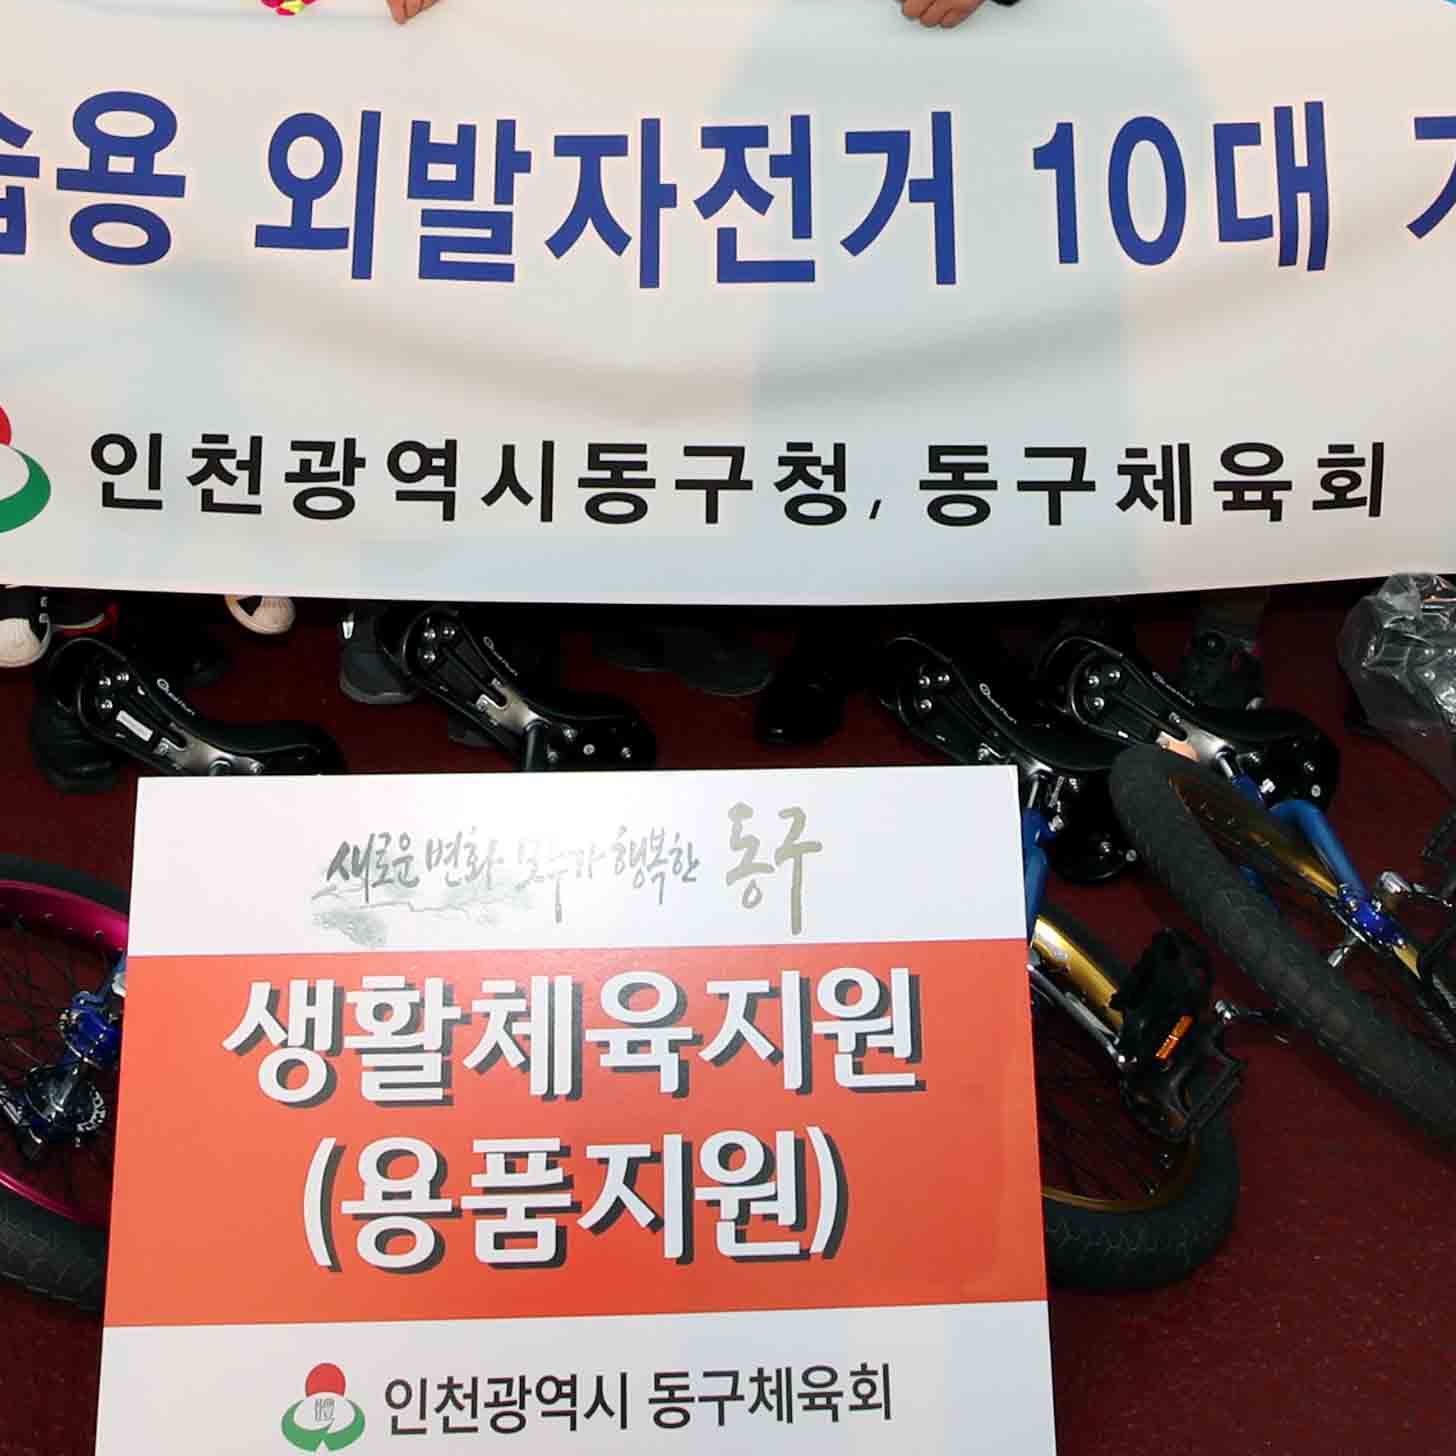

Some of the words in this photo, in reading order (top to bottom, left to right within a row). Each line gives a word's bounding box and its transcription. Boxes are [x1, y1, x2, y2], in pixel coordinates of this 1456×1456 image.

[255, 111, 956, 289] 외발자전거
[1033, 101, 1329, 272] 10대
[90, 432, 882, 526] 인천광역시동구청,
[919, 442, 1385, 527] 동구체육회
[326, 831, 420, 903] 새로운
[613, 824, 702, 905] 행복한
[725, 802, 823, 935] 동구
[222, 966, 925, 1106] 생활체육지원
[303, 1125, 848, 1272] (용품지원)
[385, 1372, 628, 1436] 인천광역시
[648, 1361, 892, 1430] 동구체육회
